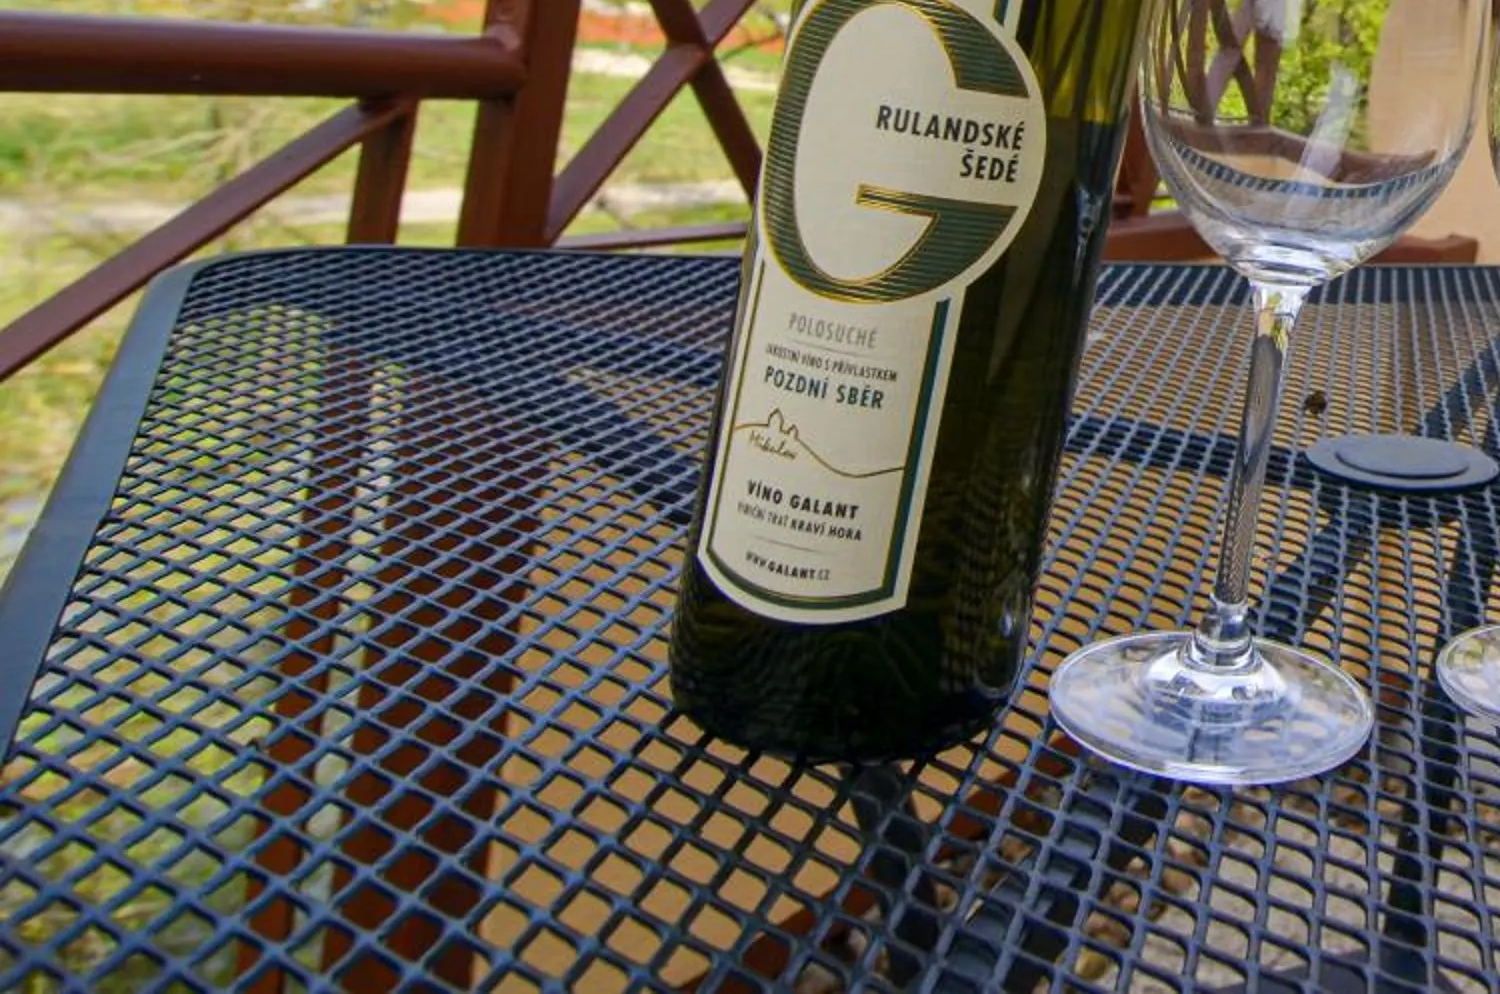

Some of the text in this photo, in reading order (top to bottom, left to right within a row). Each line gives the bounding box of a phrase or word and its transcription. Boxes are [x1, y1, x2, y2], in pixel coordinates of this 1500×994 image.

[875, 104, 1026, 151] RULANDSKÉ
[959, 149, 1019, 184] ŠEDÉ
[787, 311, 879, 349] POLOSUCHÉ
[764, 365, 885, 409] POZDNÍ SBĚR
[747, 479, 859, 519] VÍNO GALANT
[827, 524, 862, 541] HORA
